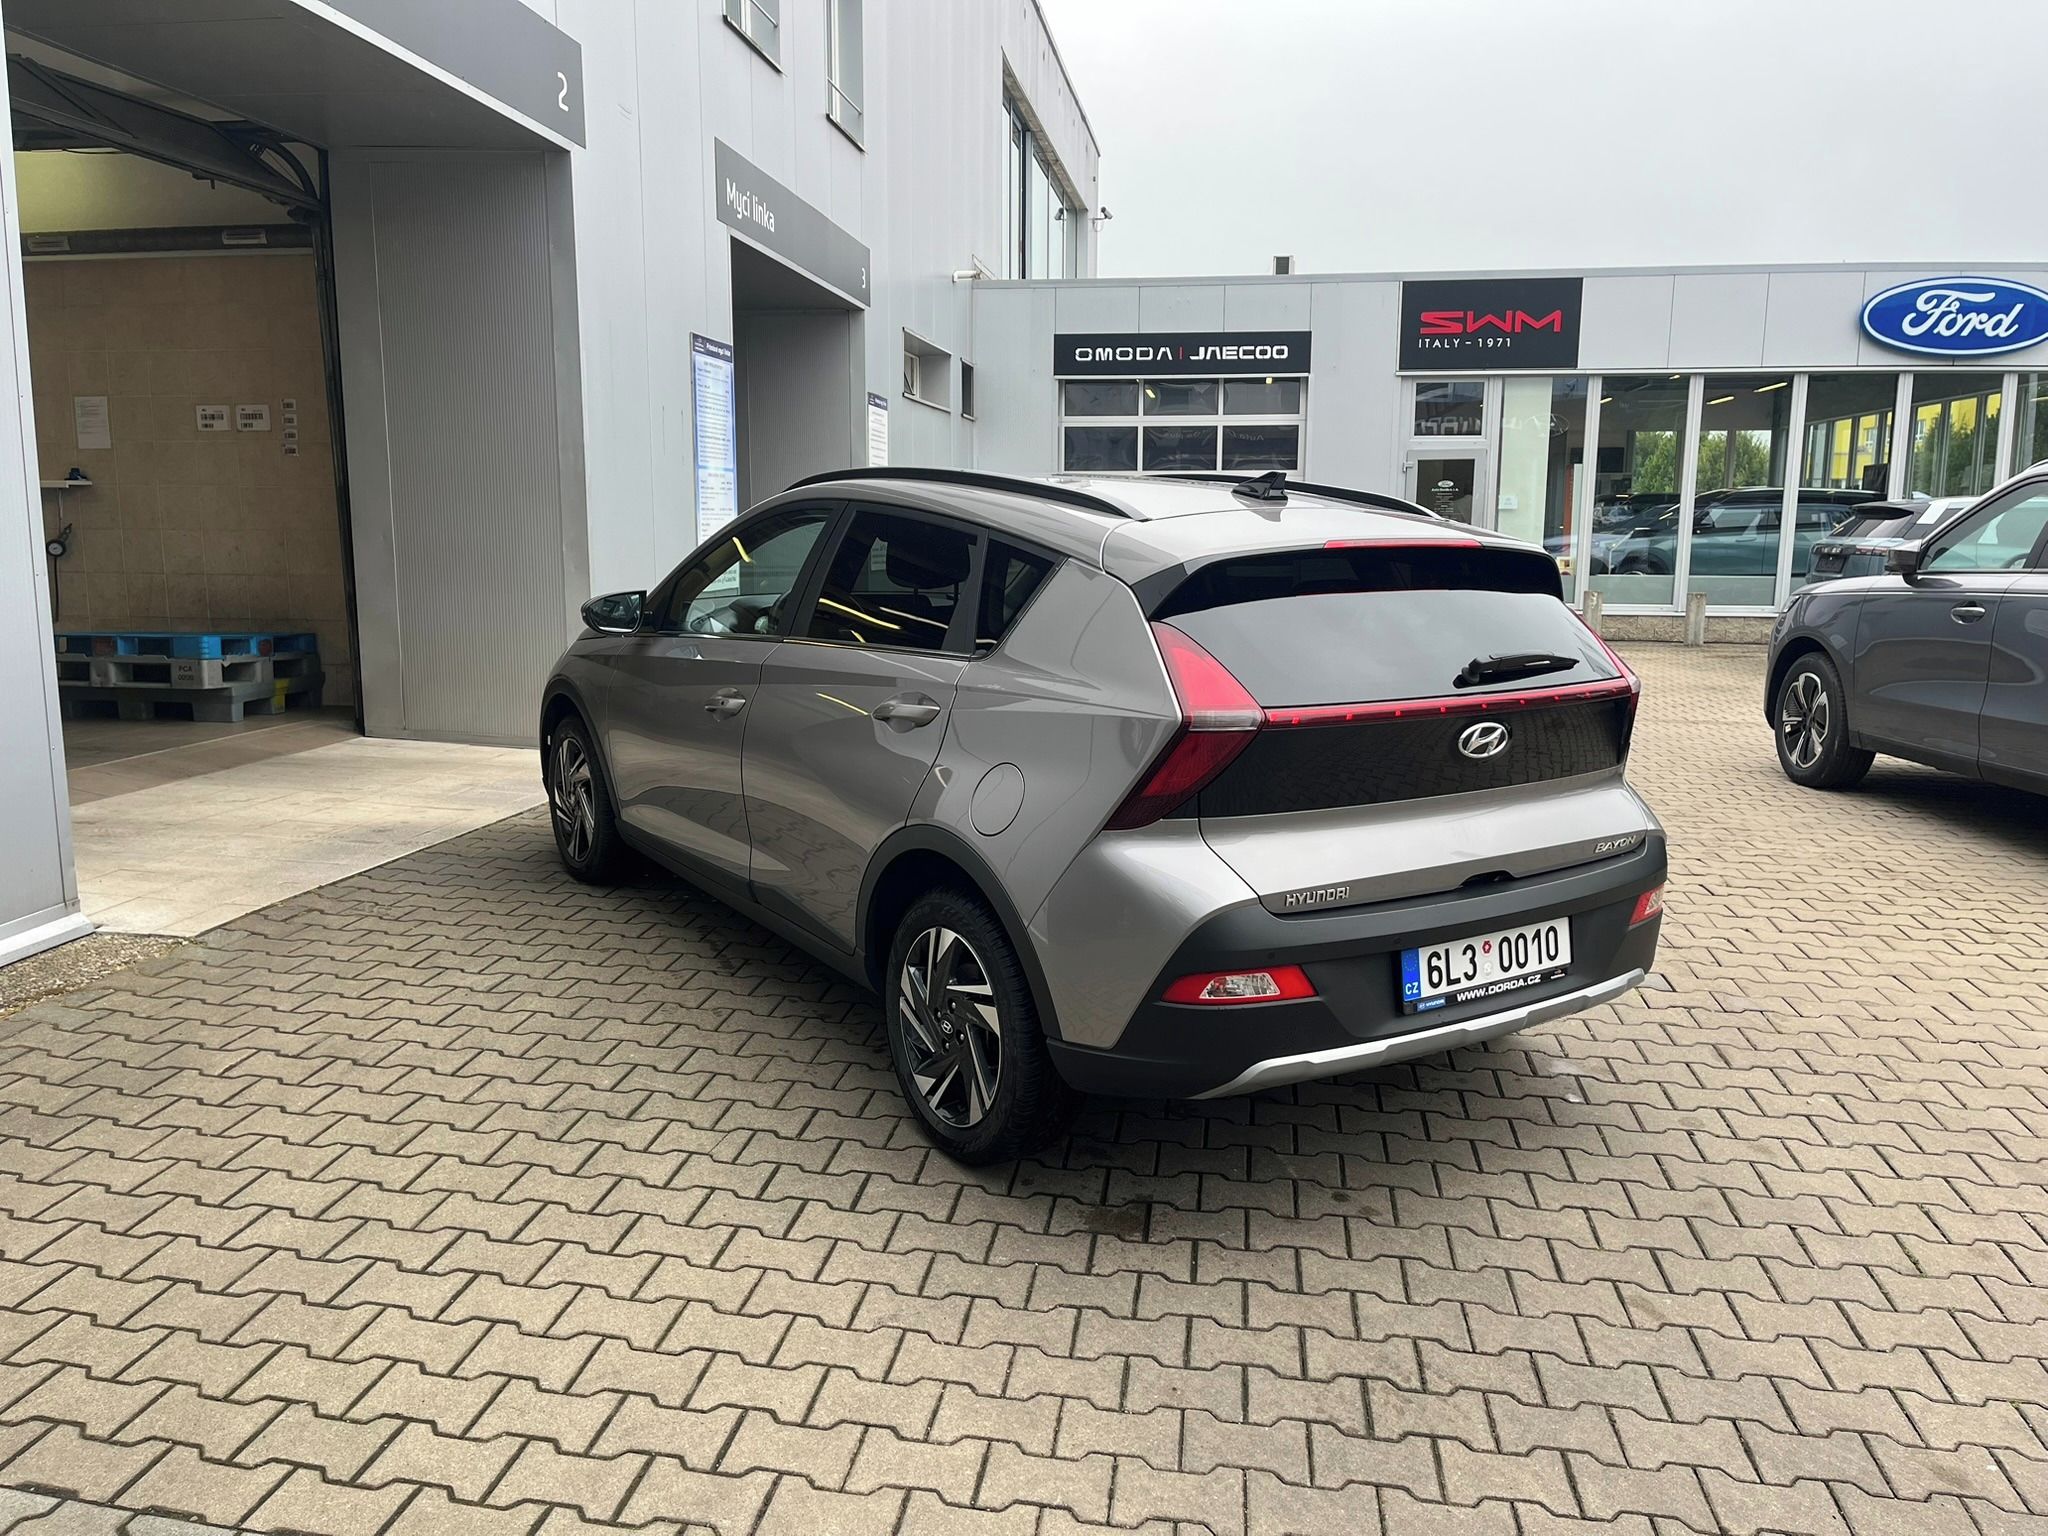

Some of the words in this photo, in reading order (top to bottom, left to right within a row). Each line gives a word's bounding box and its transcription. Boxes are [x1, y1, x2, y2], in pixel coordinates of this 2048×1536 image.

[557, 71, 569, 112] 2
[726, 177, 750, 220] Mycí
[752, 194, 775, 233] linka
[861, 267, 866, 289] 3
[1420, 309, 1562, 335] SWM
[1902, 289, 2025, 338] Ford
[1075, 346, 1173, 361] OMODA
[1189, 345, 1289, 360] JAECOO
[1418, 338, 1461, 348] ITALY
[1477, 337, 1512, 348] 1971
[1594, 835, 1636, 853] BAYON
[1285, 886, 1350, 907] HYUNDAI
[1427, 943, 1477, 989] 6L3
[1498, 925, 1559, 973] 0010
[1405, 982, 1419, 995] CZ
[1456, 974, 1542, 1002] WWW.DORDA.CZ
